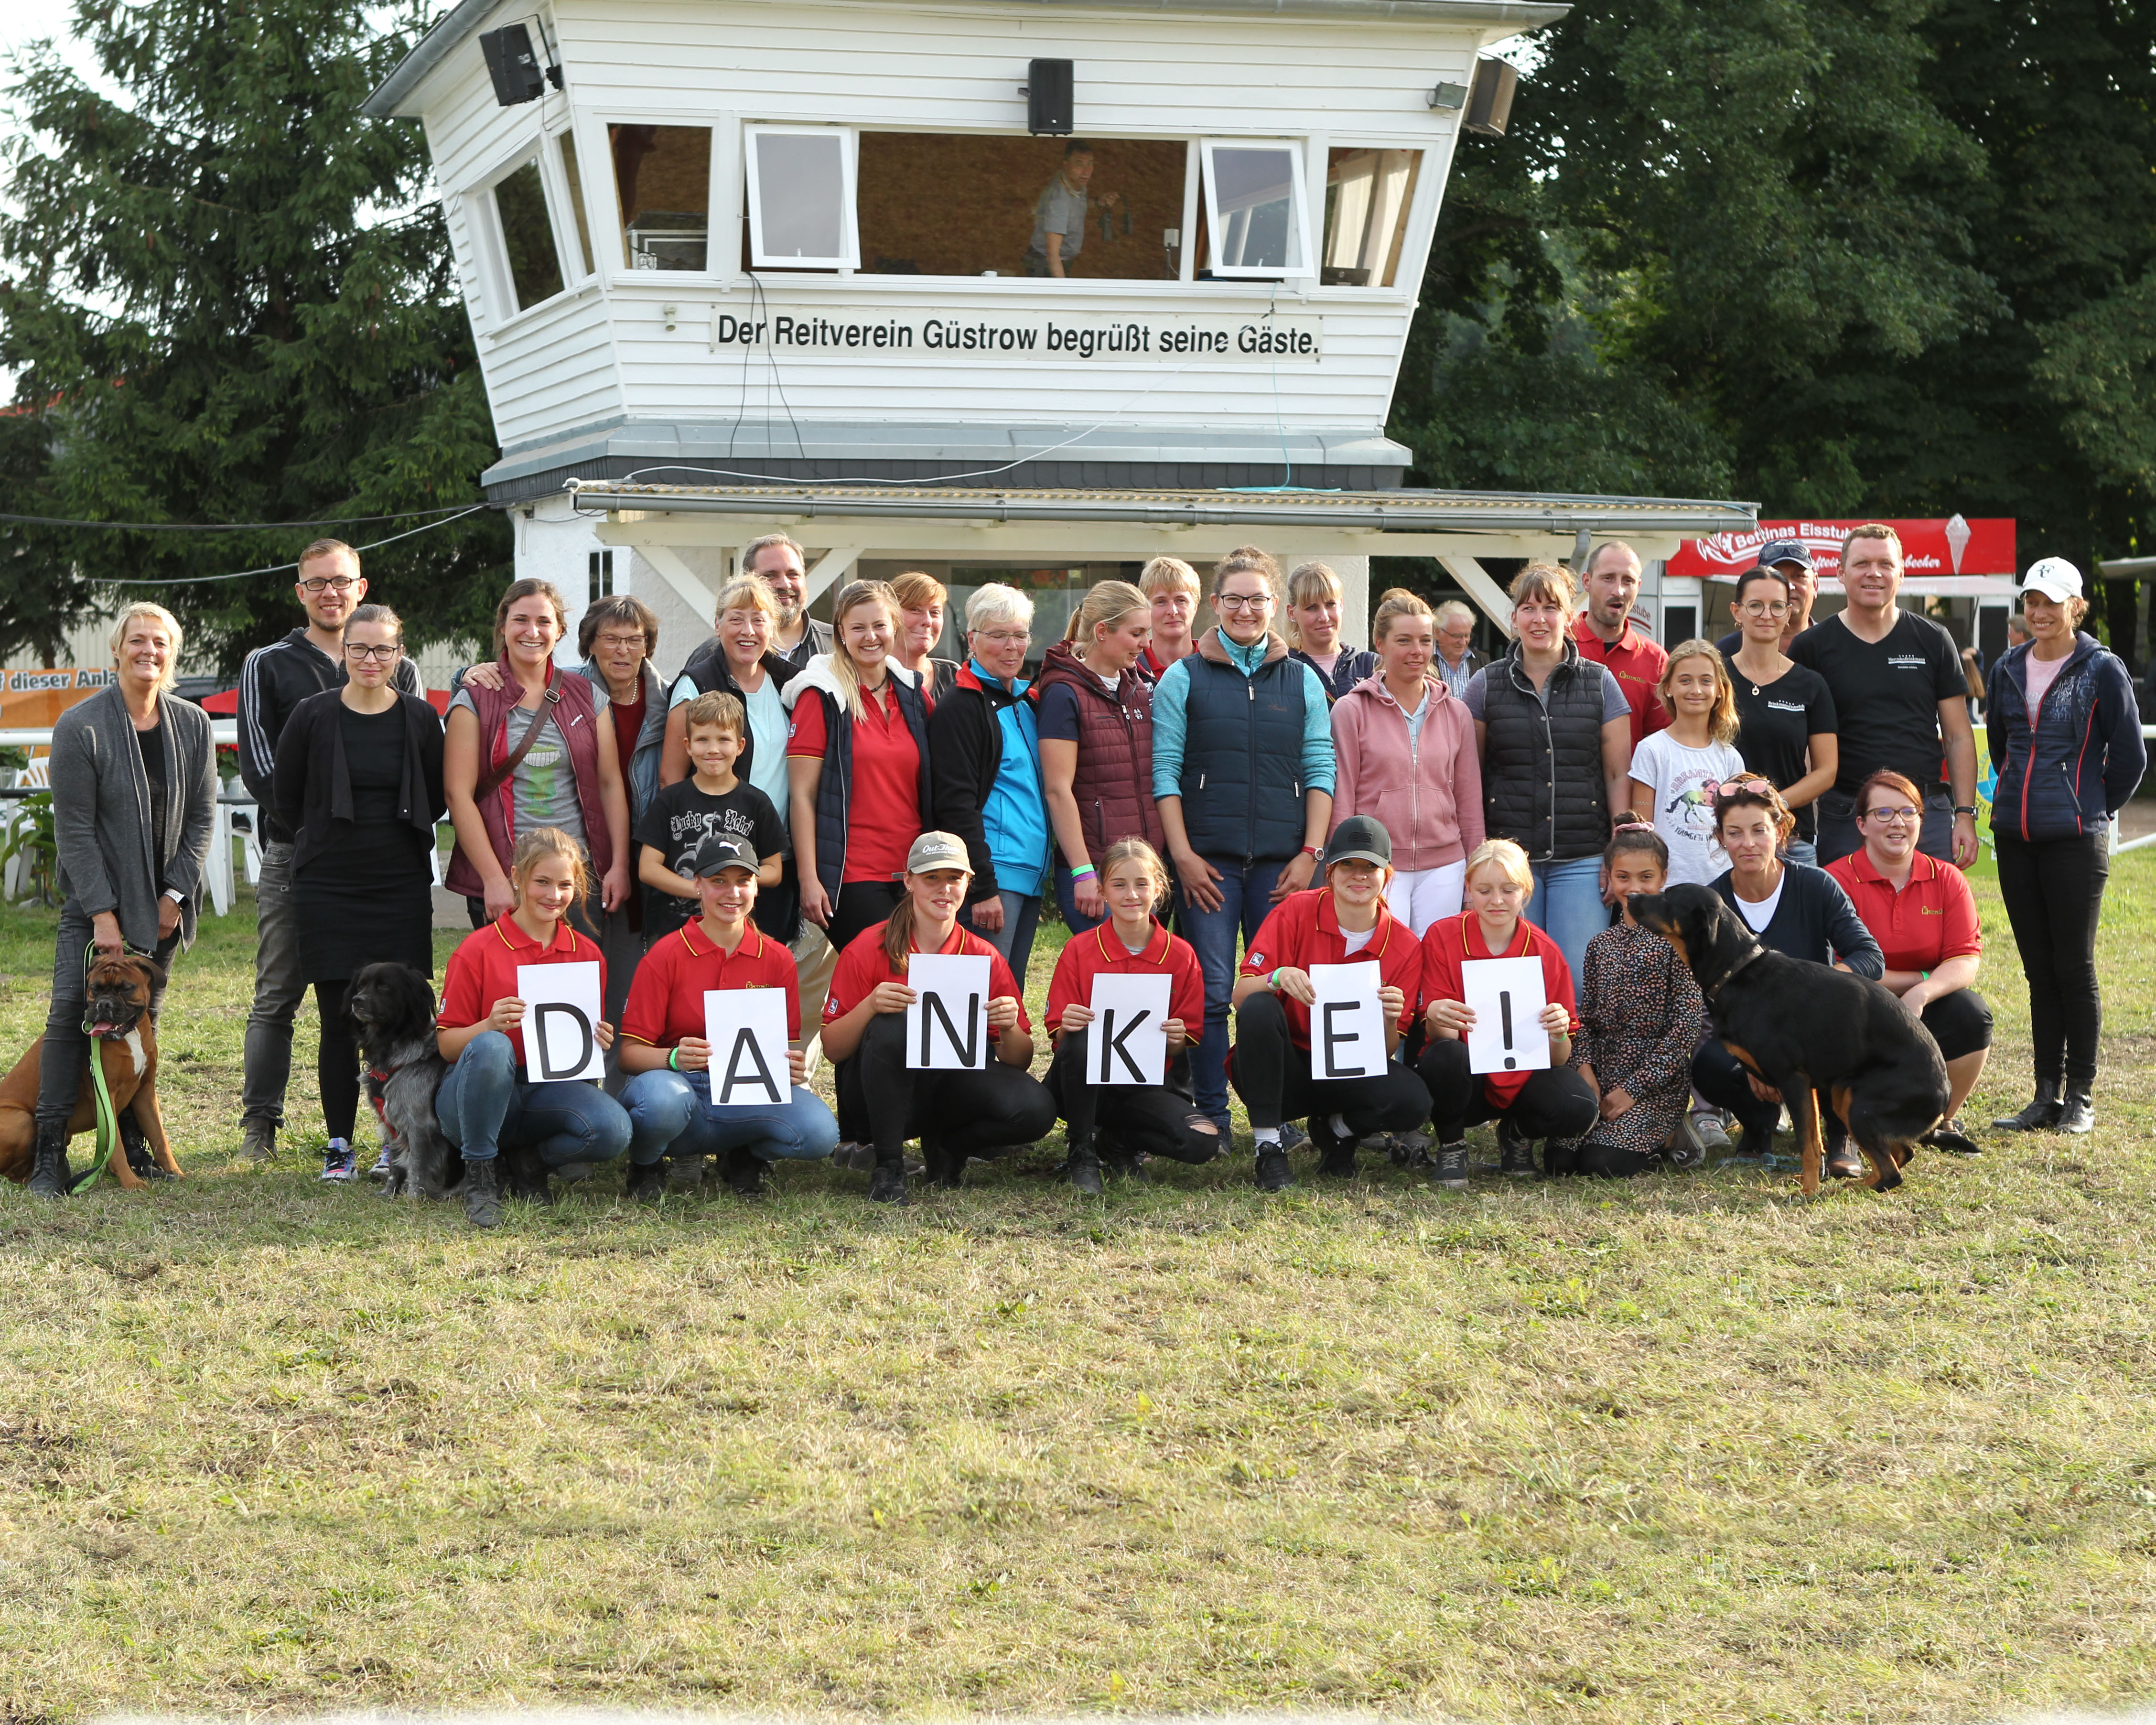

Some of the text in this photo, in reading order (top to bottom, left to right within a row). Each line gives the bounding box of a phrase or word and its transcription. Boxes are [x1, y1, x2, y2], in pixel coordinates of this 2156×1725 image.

[718, 314, 1320, 358] Der Reitverein Güstrow begrüßt seine Gäste.
[1735, 526, 1796, 549] Bettinas
[1902, 553, 1941, 569] becher
[1630, 604, 1651, 621] stube
[10, 672, 70, 691] dieser
[670, 809, 755, 841] Lucky Rebel
[535, 1002, 593, 1080] D
[921, 991, 979, 1068] N
[1100, 1009, 1151, 1083] K
[1323, 1001, 1366, 1077] E
[719, 1028, 782, 1104] A
